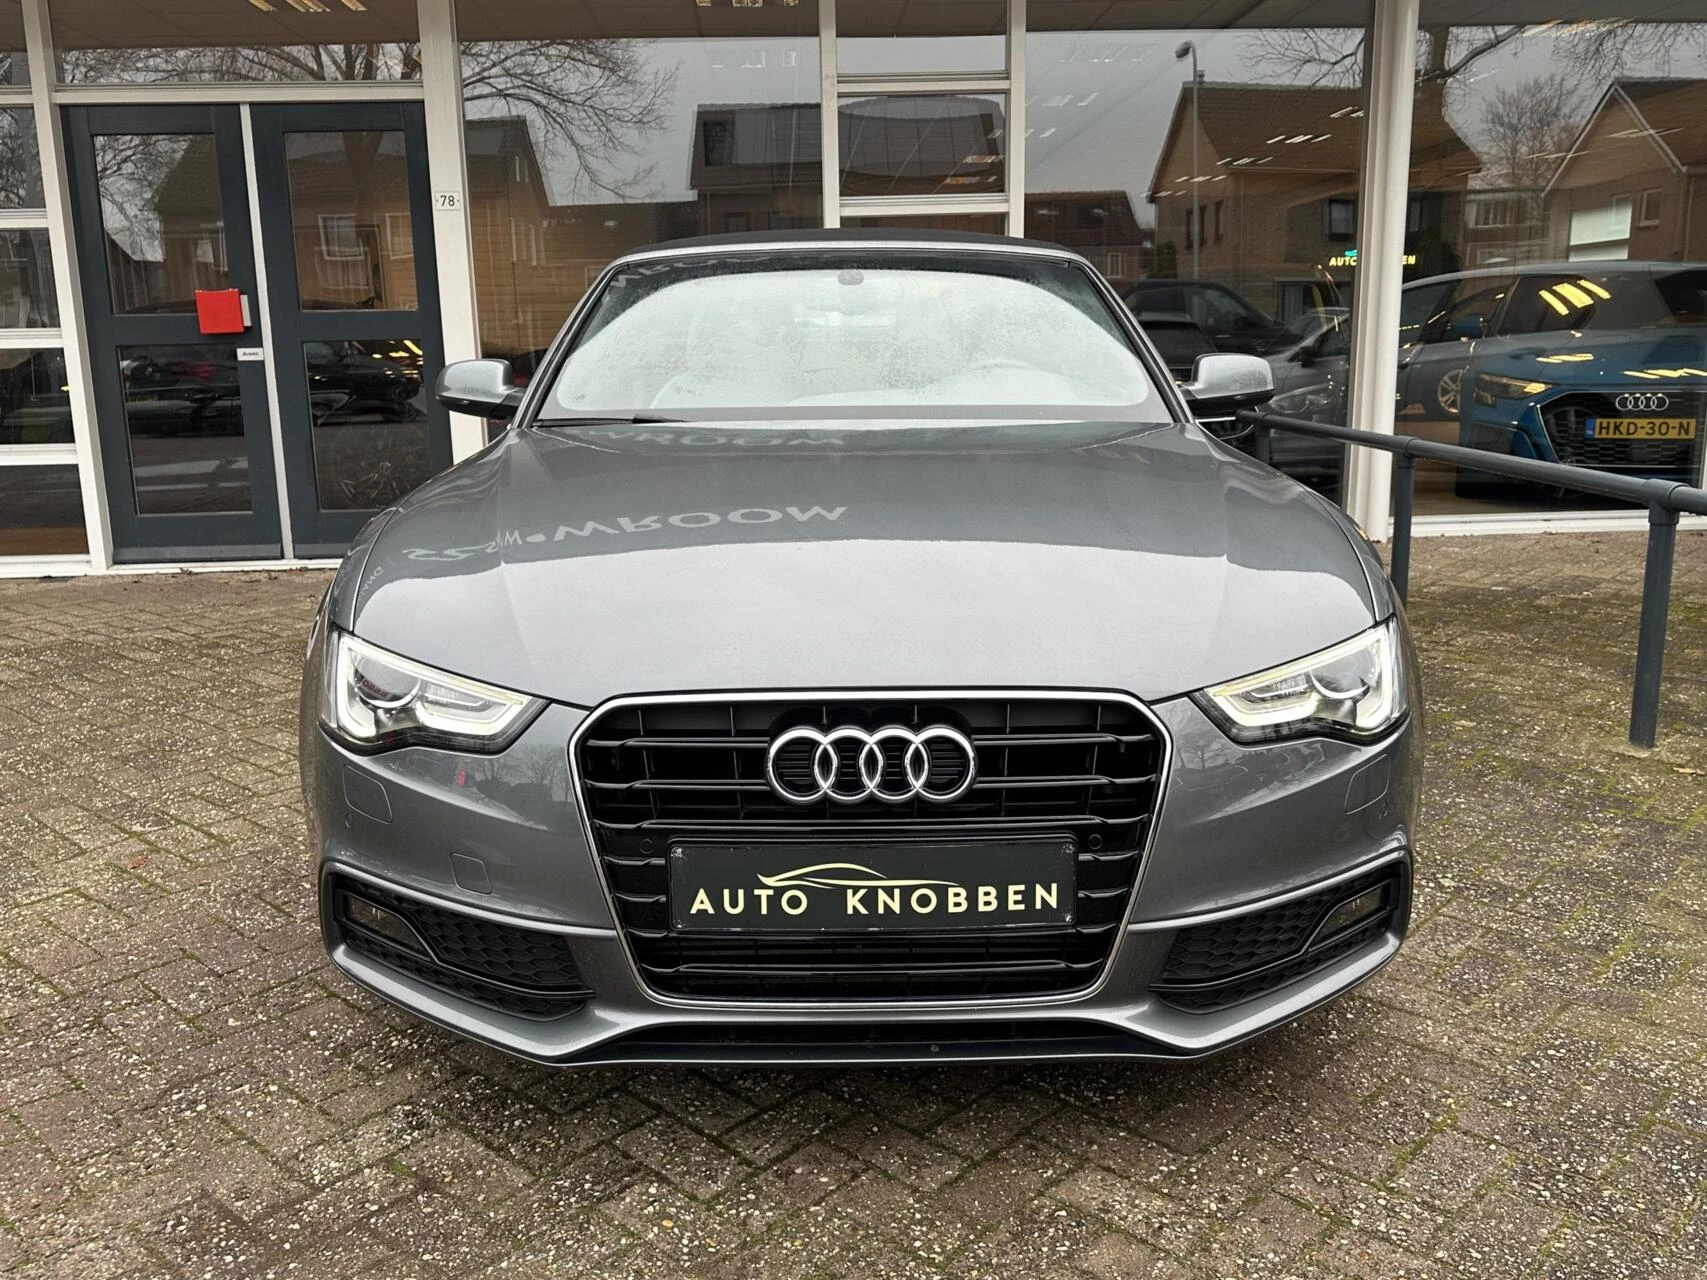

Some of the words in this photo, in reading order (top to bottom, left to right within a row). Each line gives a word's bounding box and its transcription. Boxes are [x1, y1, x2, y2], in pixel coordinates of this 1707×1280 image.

[440, 195, 455, 207] 78
[1598, 421, 1690, 436] HKD-30-N
[689, 888, 808, 916] AUTO
[846, 883, 1059, 916] KNOBBEN
